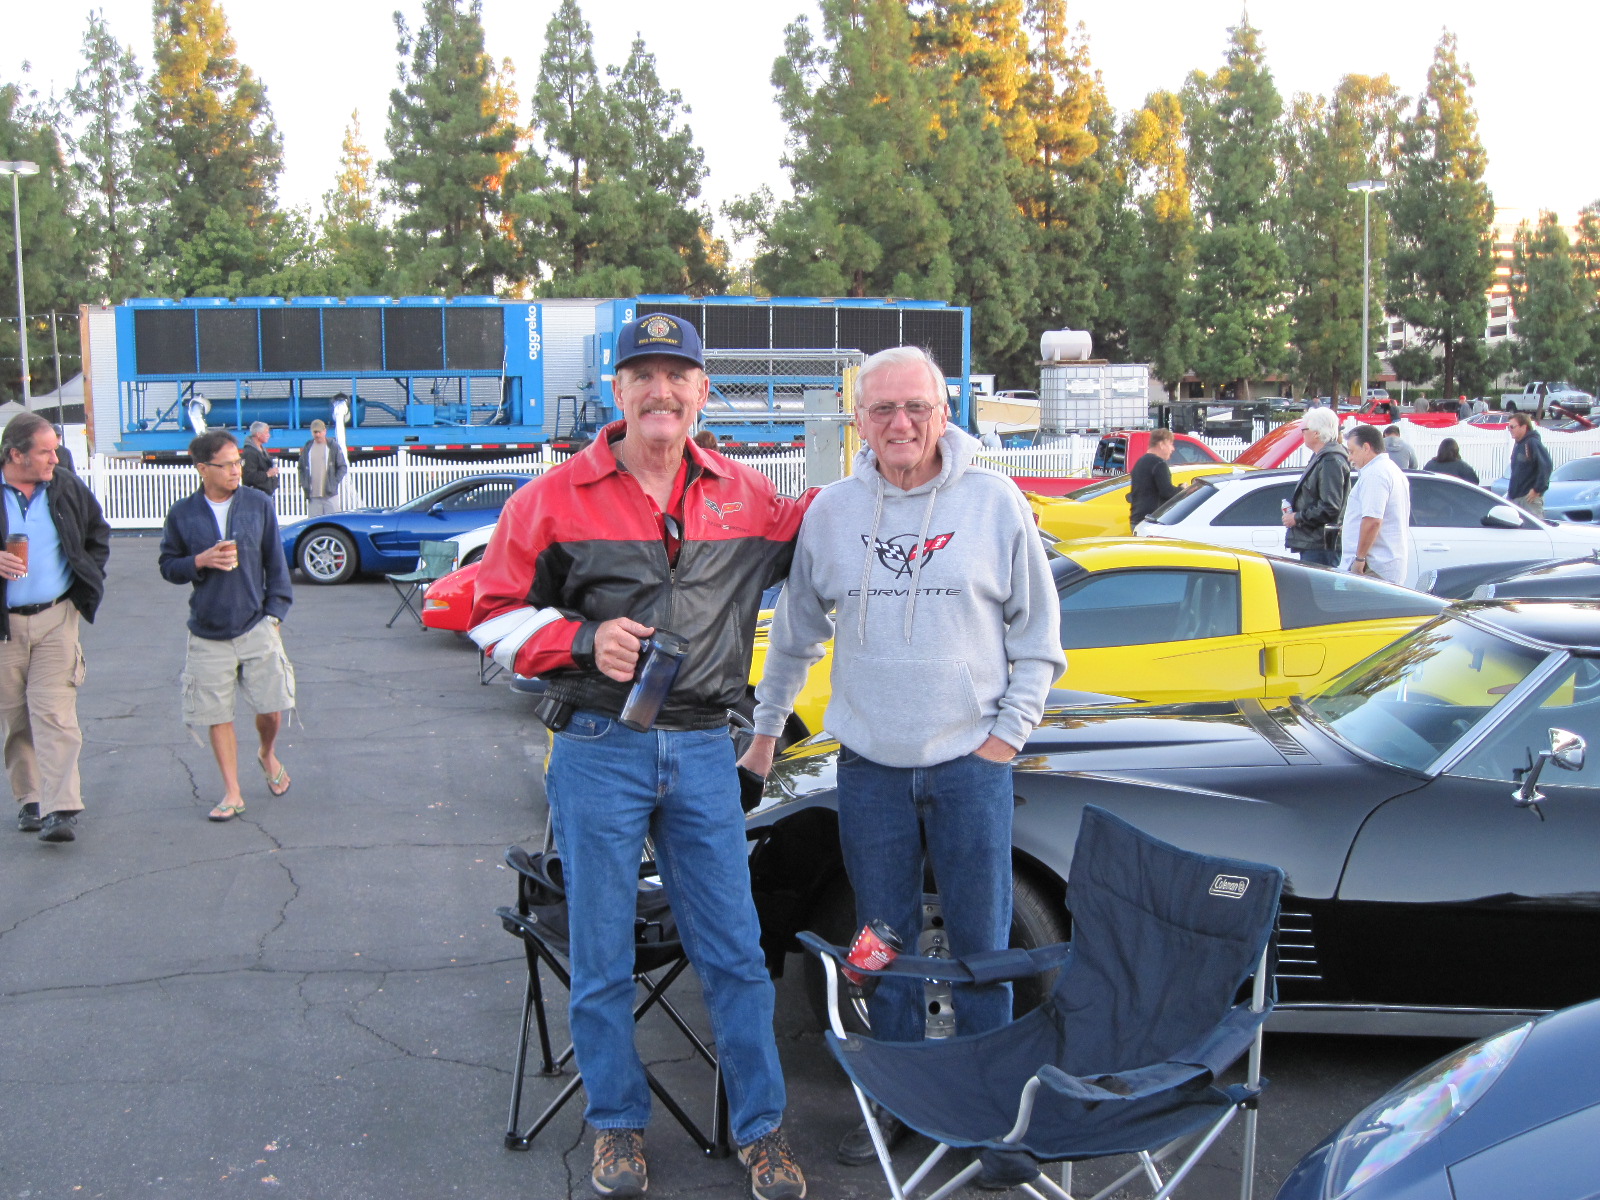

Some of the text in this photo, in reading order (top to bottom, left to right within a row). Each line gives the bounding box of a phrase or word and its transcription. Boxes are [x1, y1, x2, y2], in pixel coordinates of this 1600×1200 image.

[525, 305, 540, 360] aggreko
[848, 588, 961, 596] CORVETTE
[1214, 877, 1239, 891] Coleman
